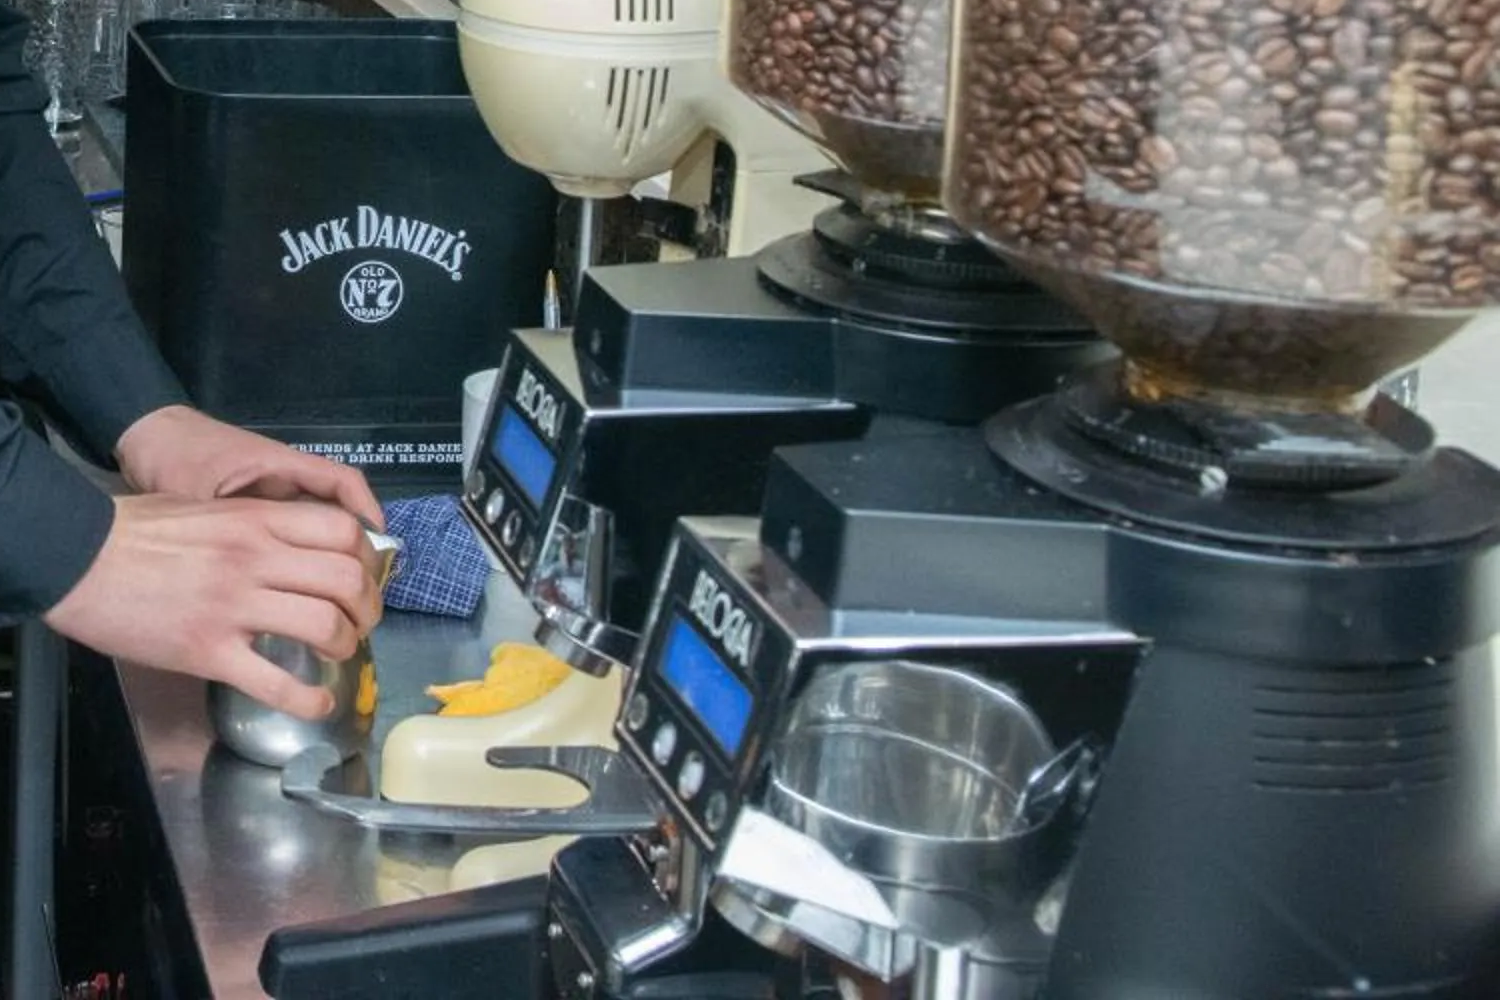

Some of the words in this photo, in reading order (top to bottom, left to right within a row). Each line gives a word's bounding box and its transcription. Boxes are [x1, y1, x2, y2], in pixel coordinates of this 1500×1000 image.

[361, 266, 385, 278] OLD
[355, 443, 373, 453] AT
[377, 443, 414, 453] JACK
[417, 443, 467, 453] DANIE
[349, 454, 395, 463] DRINK
[398, 454, 465, 463] RESPONS
